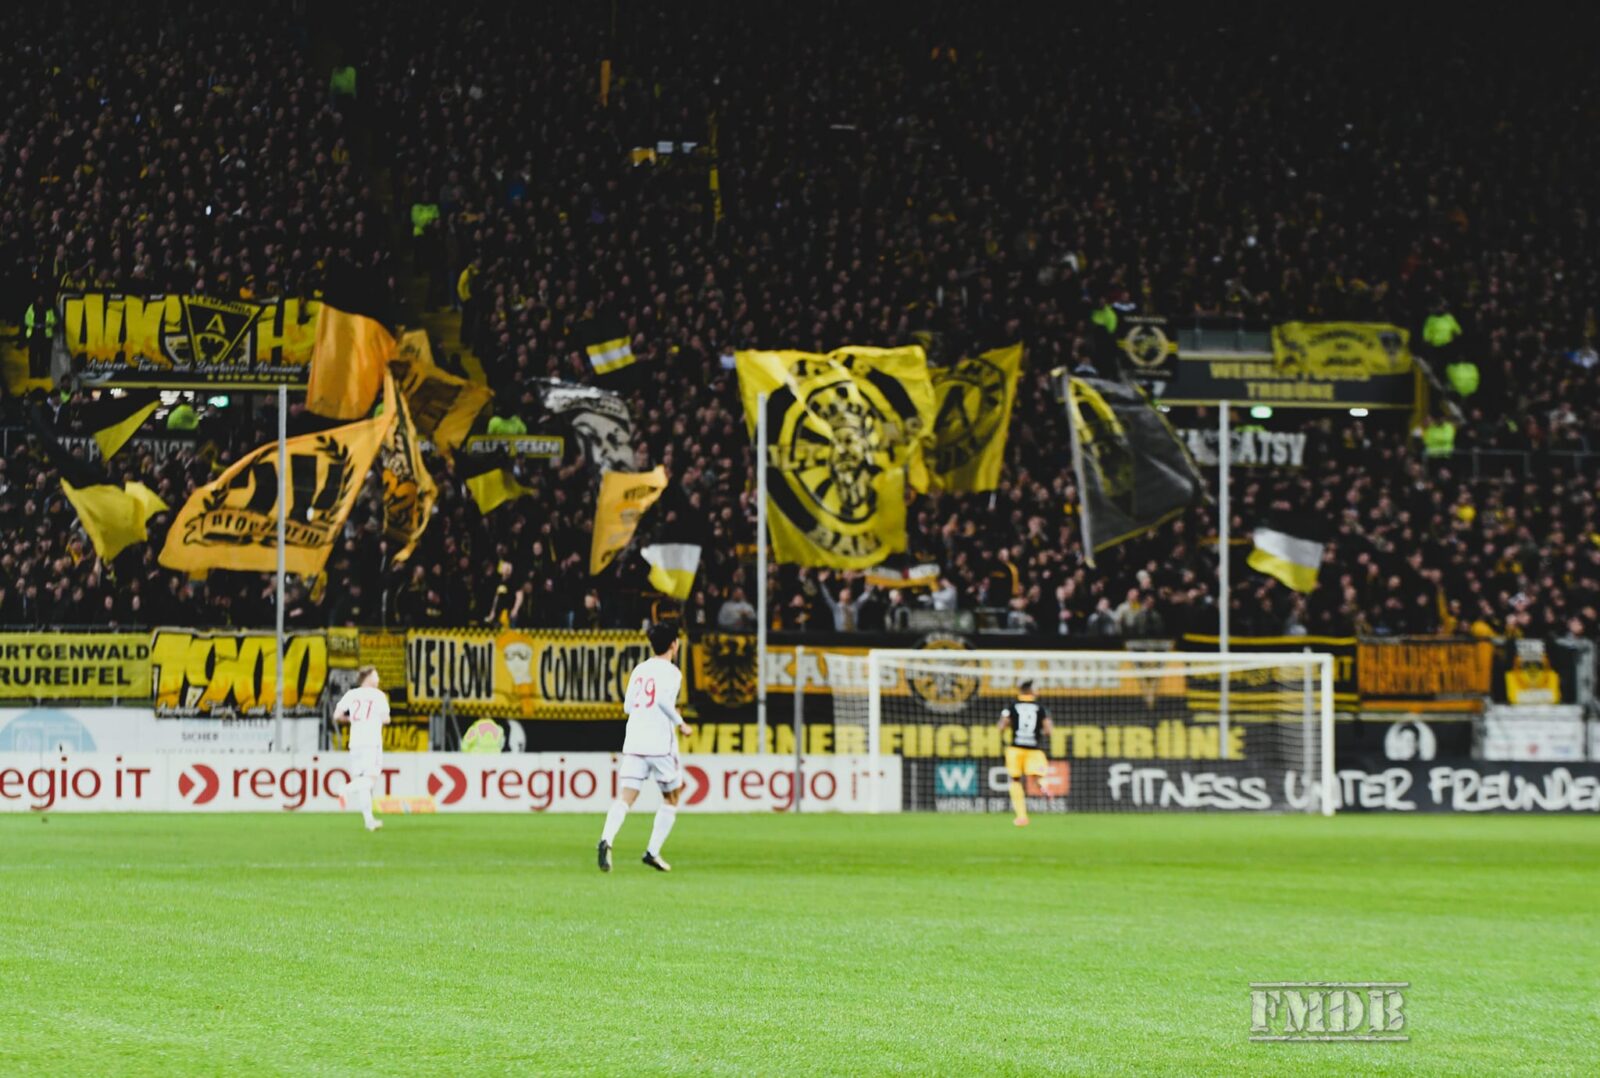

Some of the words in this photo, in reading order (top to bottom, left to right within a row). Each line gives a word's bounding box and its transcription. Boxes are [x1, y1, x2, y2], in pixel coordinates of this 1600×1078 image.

[408, 638, 494, 699] YELLOW
[633, 677, 656, 709] 29
[352, 699, 374, 720] 27
[233, 756, 351, 810] regio
[481, 758, 597, 811] regio
[724, 758, 837, 812] regio
[1108, 763, 1273, 810] FITNESS
